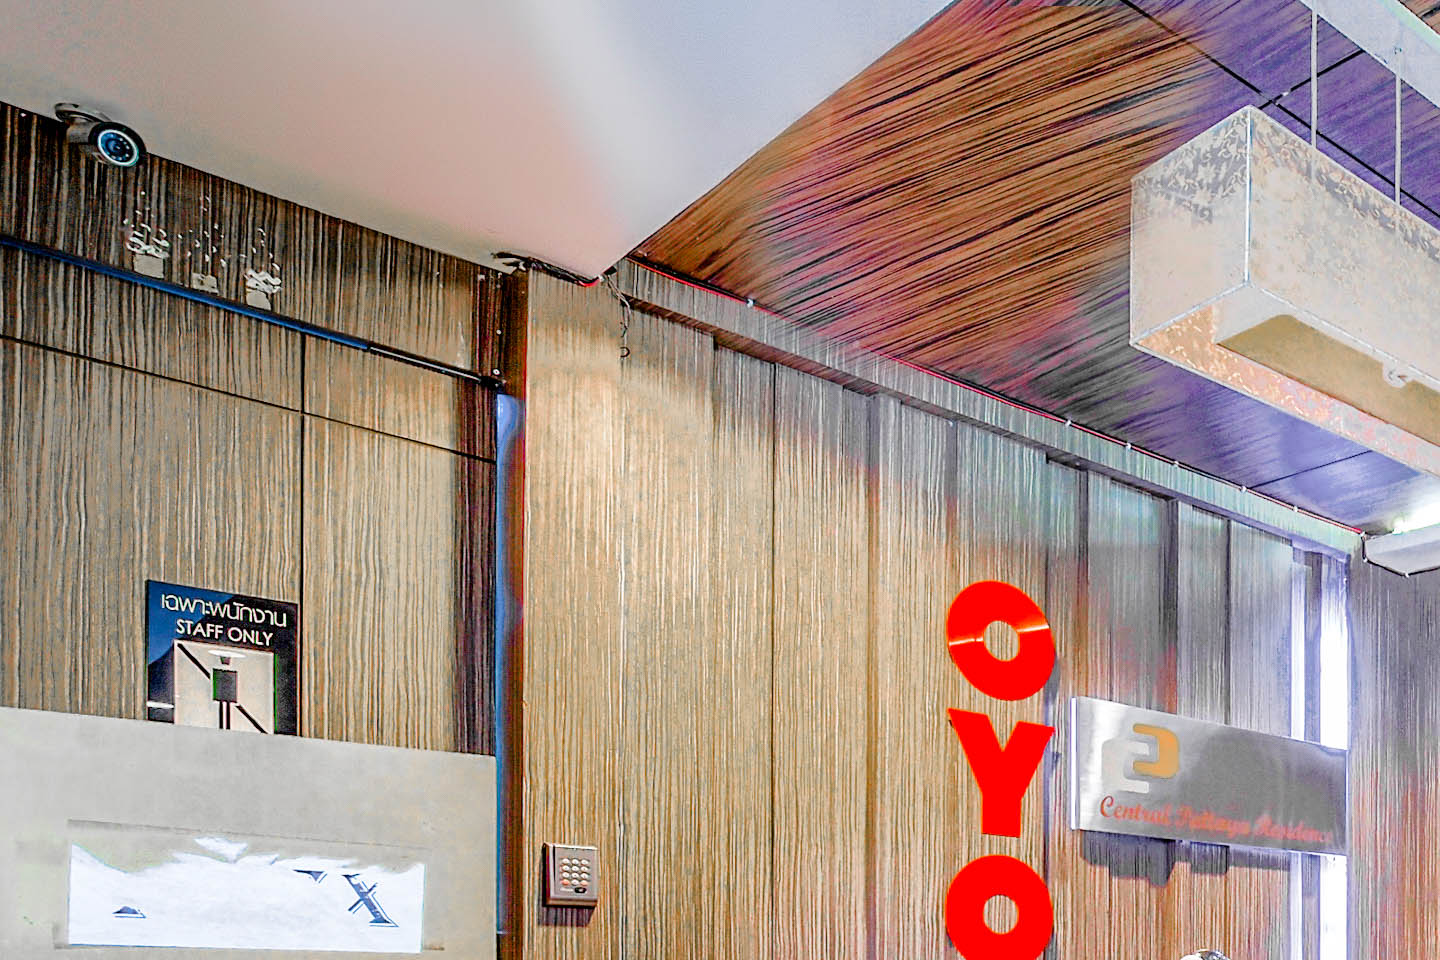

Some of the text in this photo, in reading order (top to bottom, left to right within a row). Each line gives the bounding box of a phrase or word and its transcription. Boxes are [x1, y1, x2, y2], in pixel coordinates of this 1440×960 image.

[161, 594, 287, 627] เฉพาะพนักงาน
[176, 618, 273, 646] STAFF ONLY
[1100, 795, 1171, 826] Central
